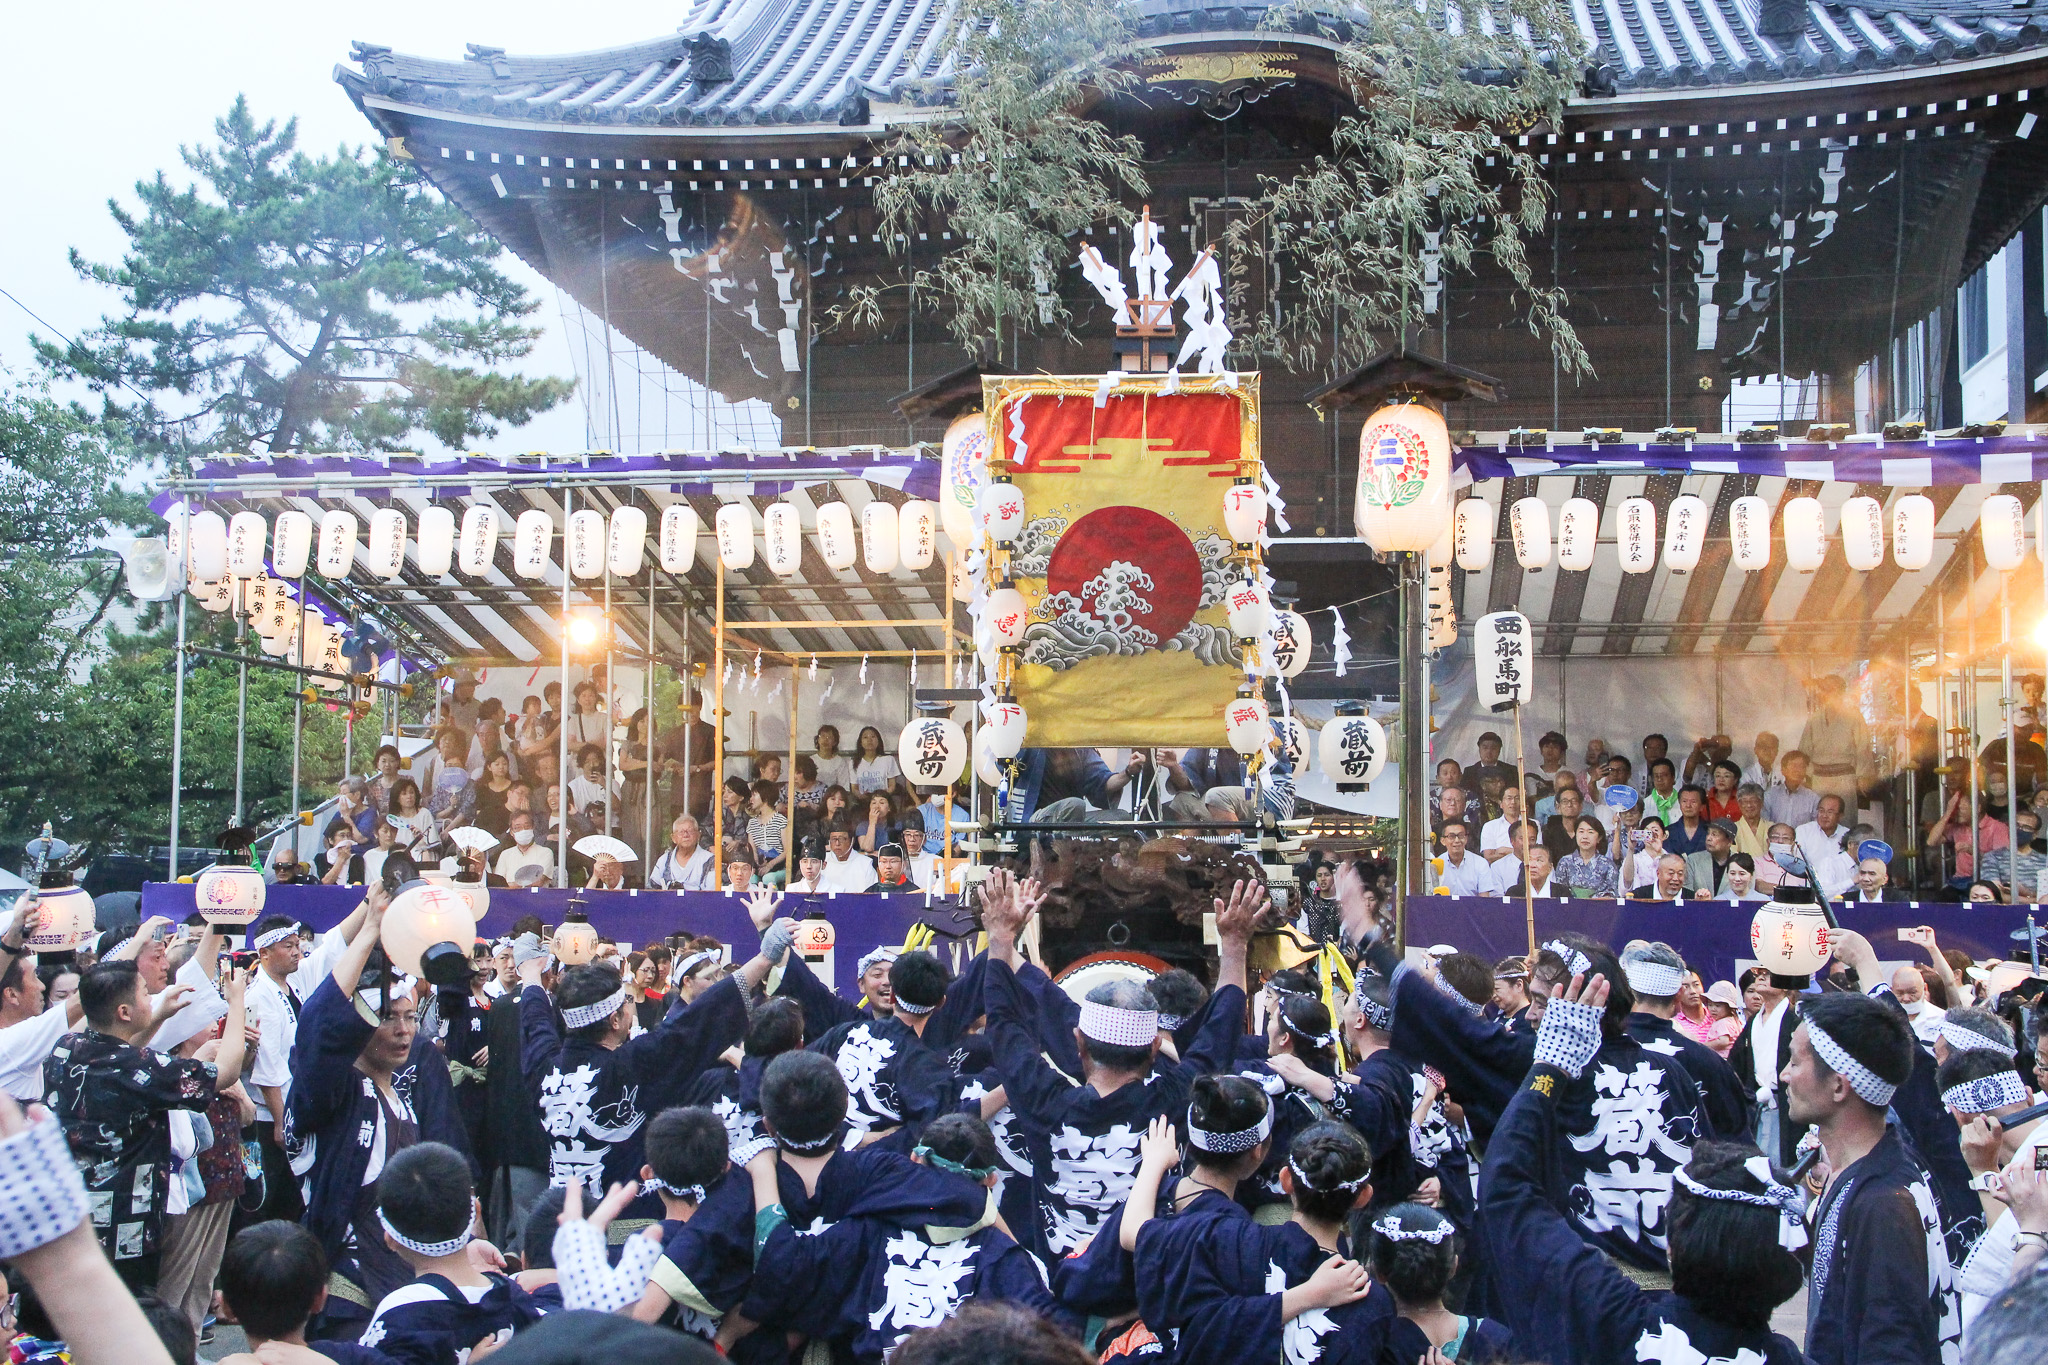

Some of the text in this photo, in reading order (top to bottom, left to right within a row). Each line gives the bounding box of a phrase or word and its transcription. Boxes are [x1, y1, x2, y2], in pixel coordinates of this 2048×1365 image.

[328, 525, 346, 565] 桑名宗社
[528, 524, 546, 565] 桑名宗社
[771, 510, 787, 564] 石取祭保存会
[820, 519, 838, 558] 桑名宗社
[917, 514, 930, 556] 桑名宗社
[1456, 513, 1468, 556] 桑名宗社
[1561, 512, 1576, 556] 桑名宗社
[1627, 504, 1642, 563] 石取祭保存会
[1672, 508, 1692, 552] 桑名宗社
[1735, 502, 1752, 559] 石取祭保存会
[1896, 511, 1908, 555] 桑名宗社
[253, 571, 268, 614] 石取祭
[273, 585, 286, 627] 石取祭
[1494, 616, 1523, 701] 西船馬町
[915, 721, 949, 778] 蔵前
[1340, 721, 1375, 778] 蔵前
[420, 889, 450, 911] 年
[1781, 921, 1794, 960] 西船馬町
[1529, 1074, 1555, 1098] 蔵
[540, 1062, 647, 1199] 蔵前
[1565, 1061, 1693, 1245] 蔵前
